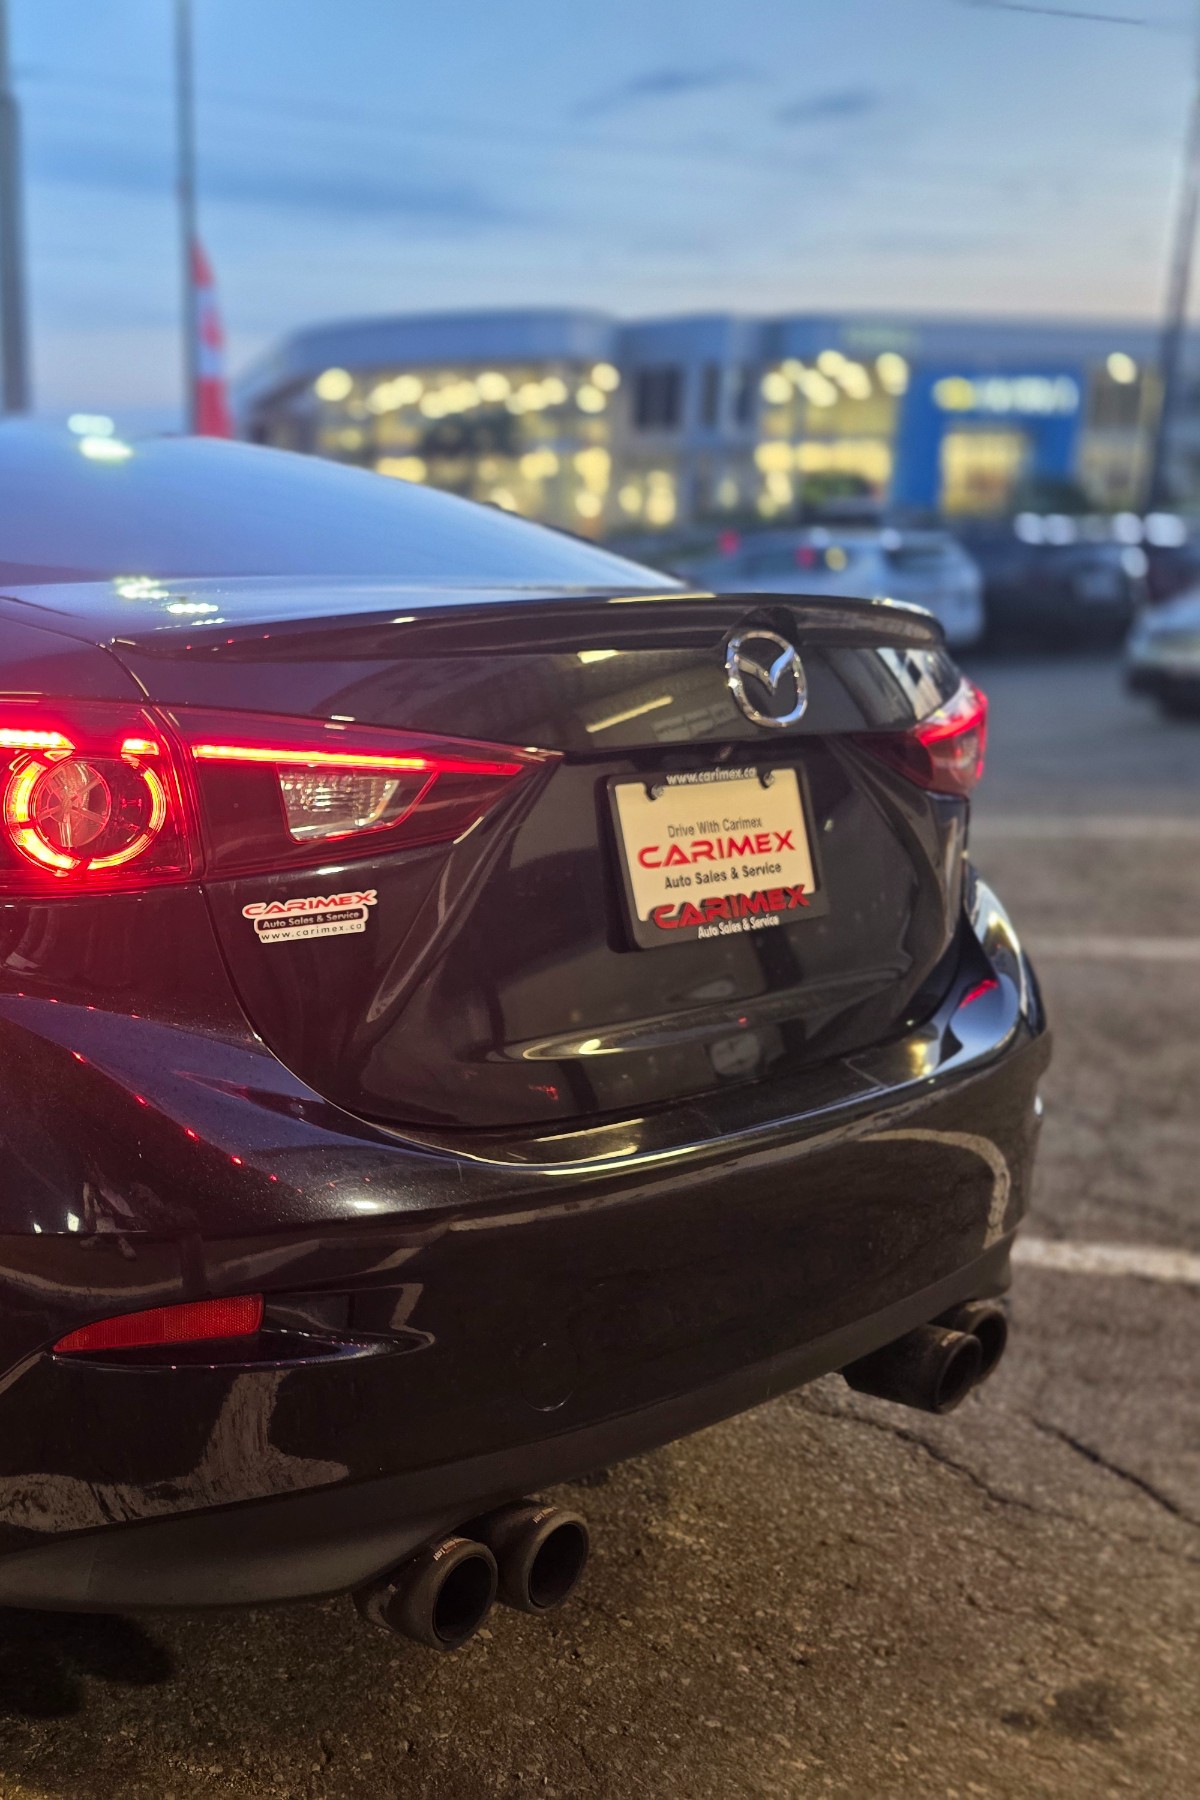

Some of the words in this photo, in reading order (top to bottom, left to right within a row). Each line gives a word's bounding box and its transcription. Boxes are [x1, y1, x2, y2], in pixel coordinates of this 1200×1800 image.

[666, 767, 757, 785] www.carimex.ca
[668, 822, 695, 838] Drive
[697, 820, 720, 835] With
[722, 816, 763, 832] Carimex
[637, 830, 796, 869] CARIMEX
[665, 874, 692, 889] Auto
[695, 870, 727, 884] Sales
[730, 867, 739, 879] &
[742, 862, 782, 878] Service
[244, 892, 375, 916] CARIMEX
[652, 884, 810, 929] CARIMEX
[261, 923, 362, 941] www.carimex.ca
[262, 919, 287, 930] Auto
[288, 916, 314, 927] Sales
[316, 914, 324, 923] &
[326, 911, 360, 922] Service
[697, 923, 719, 939] Auto
[719, 919, 743, 935] Sales
[742, 917, 751, 929] &
[750, 914, 780, 929] Service
